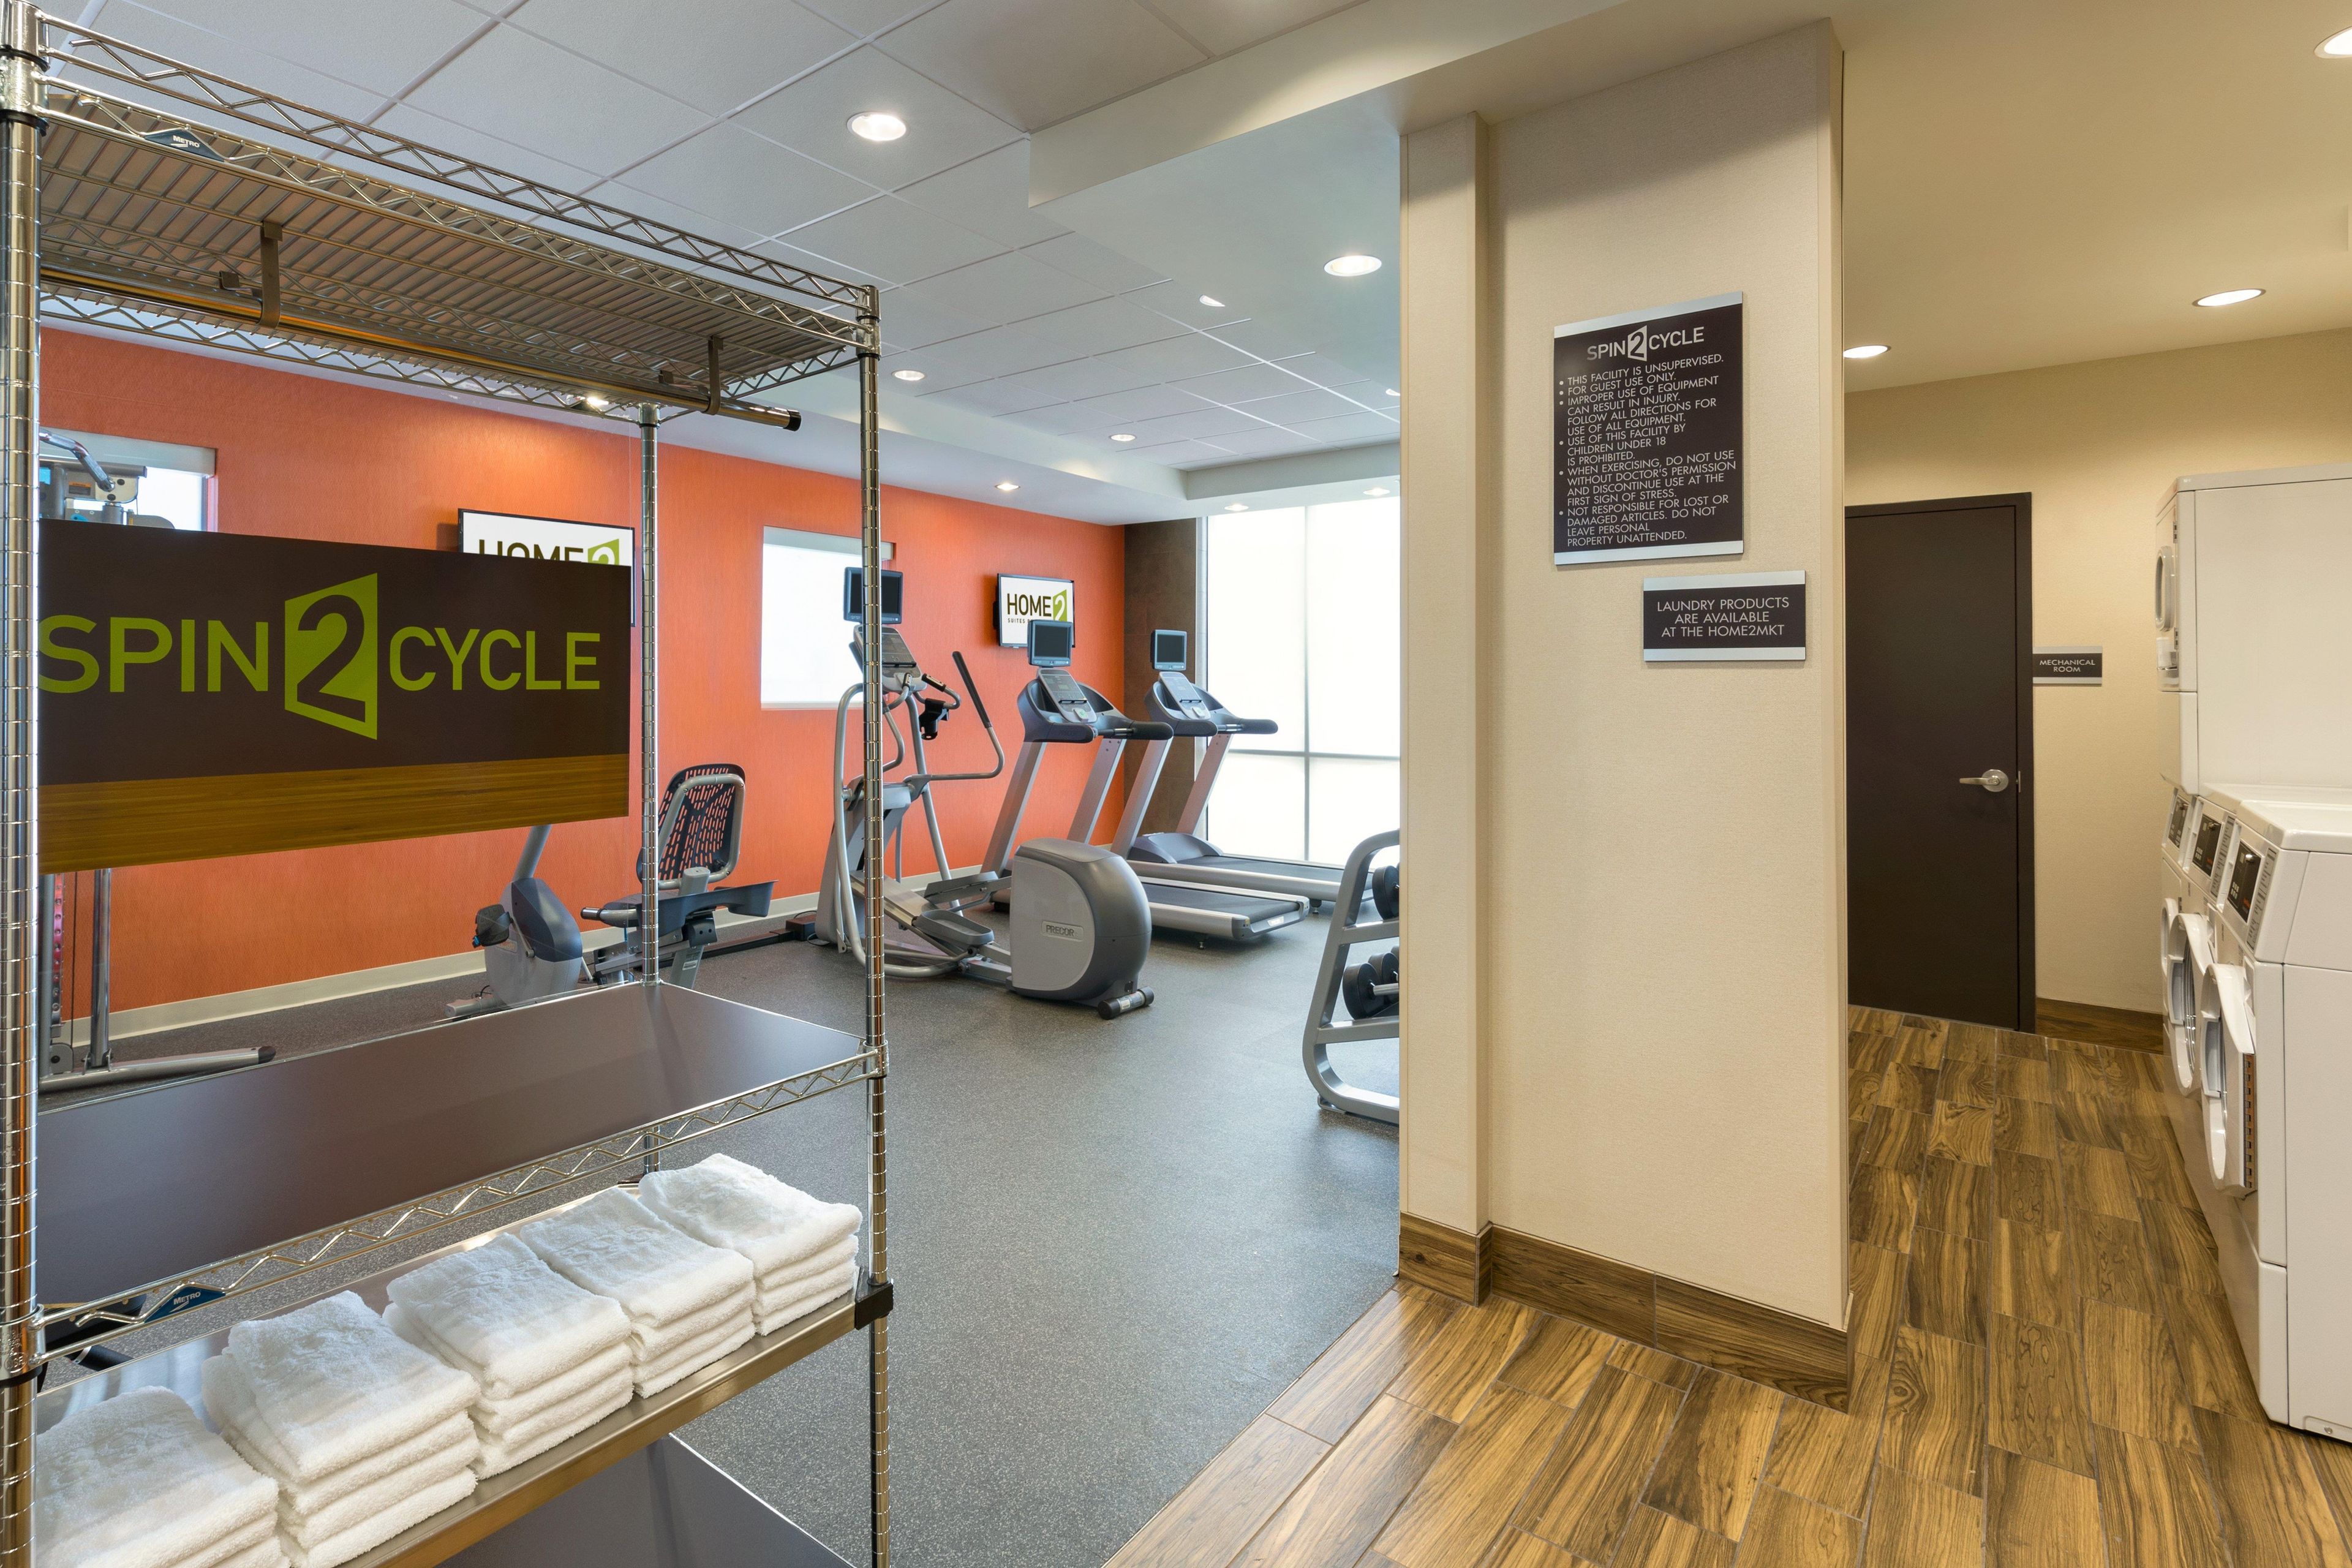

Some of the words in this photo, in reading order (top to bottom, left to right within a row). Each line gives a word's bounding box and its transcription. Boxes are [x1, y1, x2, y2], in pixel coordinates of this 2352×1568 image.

[173, 135, 200, 148] METRO
[1567, 375, 1588, 386] THIS
[1591, 368, 1629, 382] FACILITY
[1633, 366, 1642, 375] IS
[1645, 353, 1724, 374] UNSUPERVISED.
[1568, 385, 1586, 396] FOR
[1590, 380, 1621, 393] GUEST
[1625, 376, 1643, 387] USE
[1646, 371, 1676, 383] ONLY.
[1568, 391, 1614, 406] IMPROPER
[1618, 388, 1636, 399] USE
[1640, 385, 1654, 395] OF
[1658, 375, 1719, 393] EQUIPMENT
[1567, 405, 1589, 416] CAN
[1593, 399, 1625, 412] RESULT
[1629, 398, 1640, 407] IN
[1644, 392, 1680, 405] INJURY.
[1567, 412, 1607, 426] FOLLOW
[1610, 410, 1627, 420] ALL
[1630, 401, 1691, 418] DIRECTIONS
[1695, 398, 1716, 409] FOR
[1567, 426, 1585, 436] USE
[1588, 423, 1602, 434] OF
[1605, 421, 1622, 431] ALL
[1625, 412, 1686, 429] EQUIPMENT.
[1568, 435, 1585, 446] USE
[1588, 434, 1602, 443] OF
[1605, 431, 1626, 442] THIS
[1630, 425, 1670, 439] FACILITY
[1674, 423, 1686, 433] BY
[1567, 442, 1613, 456] CHILDREN
[1617, 438, 1651, 450] UNDER
[1656, 436, 1666, 445] 18
[1567, 457, 1575, 466] IS
[1579, 451, 1635, 465] PROHIBITED.
[1567, 465, 1598, 476] WHEN
[1602, 458, 1662, 473] EXERCISING,
[1666, 456, 1683, 466] DO
[1687, 452, 1710, 464] NOT
[1714, 450, 1734, 461] USE
[1567, 473, 1613, 486] WITHOUT
[1616, 468, 1668, 481] DOCTOR'S
[1672, 461, 1736, 476] PERMISSION
[1567, 486, 1589, 497] AND
[1593, 479, 1661, 494] DISCONTINUE
[1665, 477, 1684, 487] USE
[1688, 475, 1701, 485] AT
[1705, 473, 1724, 483] THE
[1567, 496, 1591, 507] FIRST
[1594, 494, 1618, 504] SIGN
[1622, 492, 1636, 502] OF
[1640, 488, 1676, 500] STRESS.
[1568, 507, 1589, 516] NOT
[1592, 500, 1655, 514] RESPONSIBLE
[1659, 499, 1679, 509] FOR
[1684, 496, 1709, 507] LOST
[1712, 494, 1728, 504] OR
[1567, 514, 1618, 527] DAMAGED
[1621, 510, 1667, 522] ARTICLES.
[1672, 508, 1689, 518] DO
[1692, 506, 1716, 517] NOT
[1567, 526, 1595, 537] LEAVE
[1599, 522, 1650, 534] PERSONAL
[1567, 535, 1613, 547] PROPERTY
[1617, 530, 1687, 543] UNATTENDED.
[1657, 600, 1715, 612] LAUNDRY
[1720, 597, 1789, 609] PRODUCTS
[1675, 613, 1698, 624] ARE
[1703, 611, 1770, 624] AVAILABLE
[1661, 627, 1676, 637] AT
[1681, 626, 1703, 637] THE
[1708, 624, 1784, 636] HOME2MKT
[173, 1292, 201, 1305] METRO
